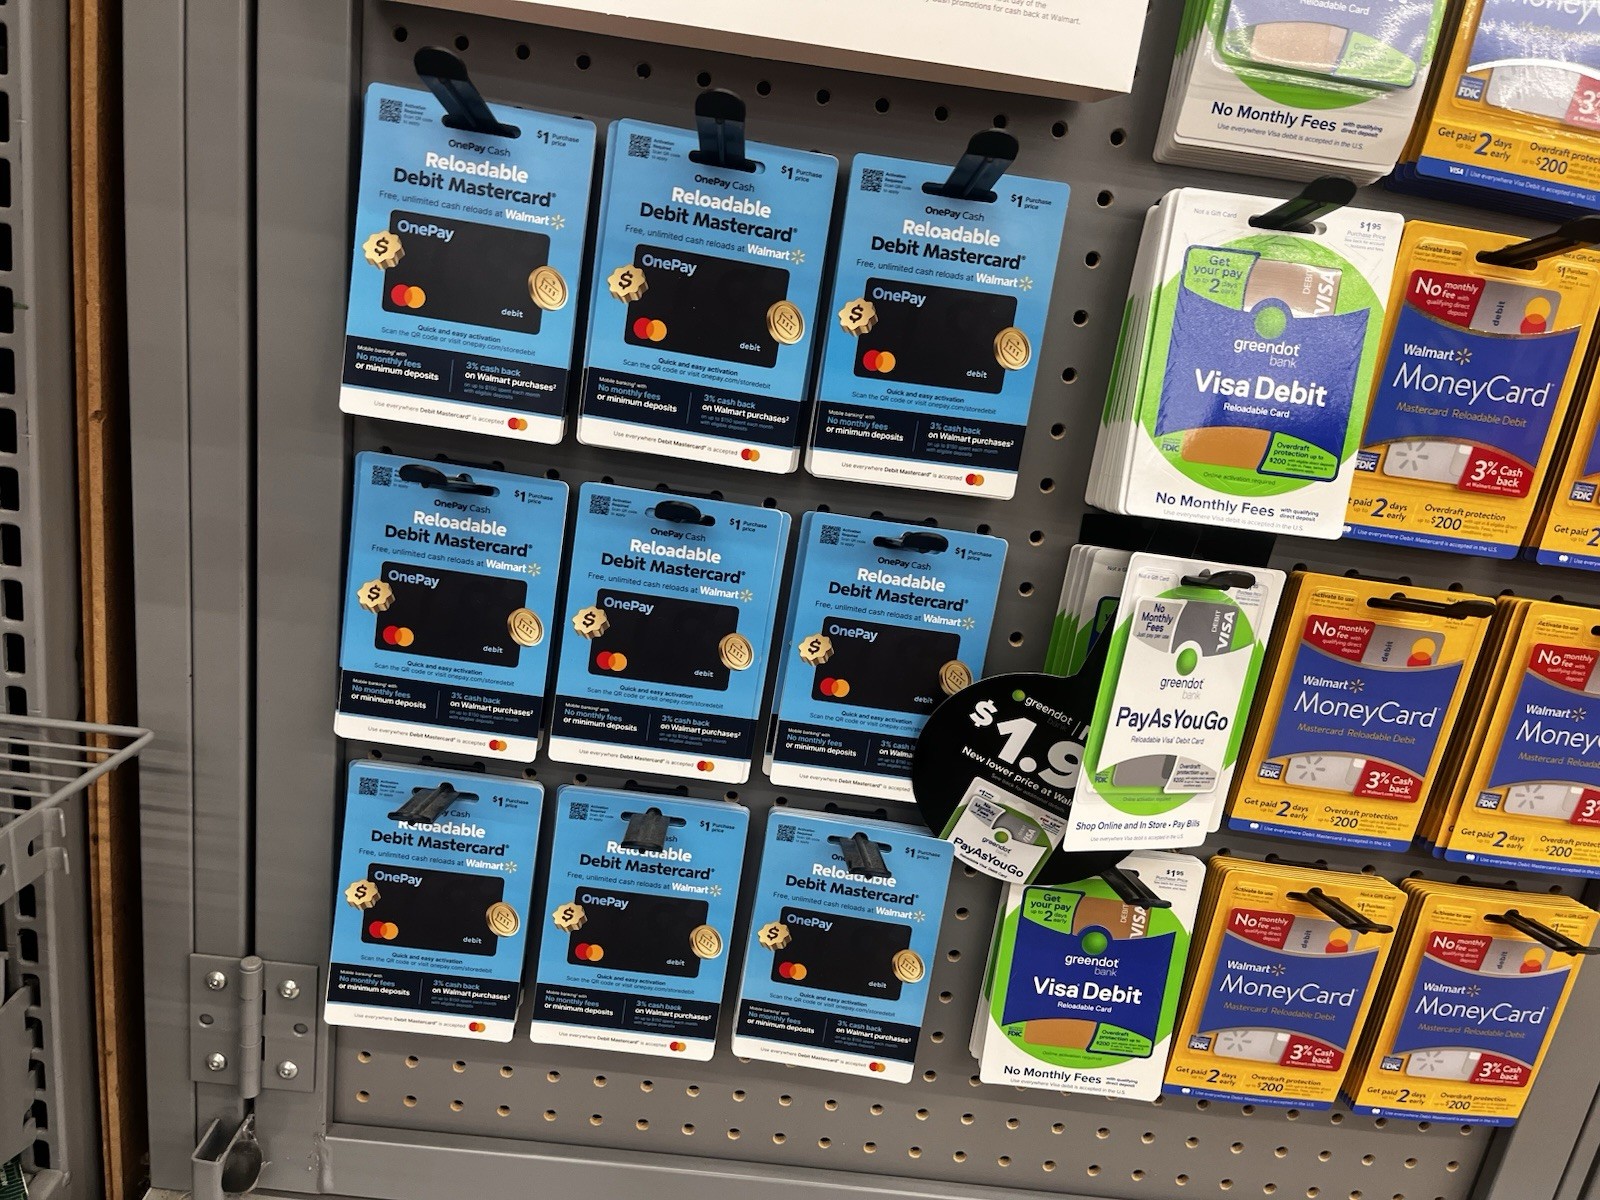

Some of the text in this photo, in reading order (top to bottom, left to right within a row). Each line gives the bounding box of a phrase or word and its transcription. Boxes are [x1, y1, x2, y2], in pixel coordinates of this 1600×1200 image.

[952, 0, 992, 11] promotions
[993, 4, 1002, 12] for
[1004, 7, 1022, 16] cash
[1023, 10, 1040, 18] back
[1050, 14, 1080, 25] Walmart.
[1458, 86, 1480, 99] FDIC
[1212, 102, 1336, 131] No Monthly Fees
[537, 130, 548, 144] $1
[1231, 125, 1266, 136] everywhere
[1268, 130, 1280, 138] Visa
[1305, 137, 1333, 146] accepted
[1438, 127, 1512, 156] Get paid 2 days
[447, 138, 511, 157] OnePay Cash
[1490, 149, 1511, 162] early
[425, 151, 529, 184] Reloadable
[1536, 157, 1568, 175] $200
[394, 168, 444, 190] Debit
[379, 190, 399, 201] Free,
[402, 196, 441, 208] unlimited
[441, 202, 460, 210] cash
[462, 204, 492, 215] reloads
[504, 208, 549, 226] Walmart
[672, 187, 770, 217] Reloadable
[640, 202, 688, 223] Debit
[398, 220, 453, 241] OnePay
[903, 220, 999, 246] Reloadable
[872, 235, 918, 255] Debit
[642, 254, 696, 276] OnePay
[1209, 255, 1231, 266] Get
[1193, 265, 1243, 279] your pay
[1209, 278, 1220, 293] 2
[1415, 277, 1441, 295] No
[873, 287, 925, 307] OnePay
[501, 309, 522, 317] debit
[417, 324, 436, 333] Quick
[468, 333, 500, 342] activation
[1234, 340, 1299, 360] greendot
[1404, 344, 1453, 360] Walmart
[356, 352, 421, 368] No monthly fees
[465, 360, 520, 377] 3% cash back
[1268, 354, 1296, 368] bank
[365, 364, 401, 374] minimum
[404, 369, 438, 380] deposits
[477, 372, 510, 384] Walmart
[1196, 369, 1329, 408] Visa Debit
[1394, 363, 1549, 406] MoneyCard
[1222, 402, 1289, 418] Reloadable Card
[1470, 460, 1497, 480] 3%
[1498, 466, 1522, 479] Cash
[1496, 476, 1518, 489] back
[1156, 492, 1274, 516] No Monthly Fees
[414, 509, 506, 535] Reloadable
[385, 525, 430, 543] Debit
[629, 538, 722, 564] Reloadable
[600, 552, 646, 571] Debit
[388, 570, 439, 588] OnePay
[858, 568, 944, 591] Reloadable
[828, 581, 871, 598] Debit
[604, 597, 653, 615] OnePay
[829, 624, 877, 642] OnePay
[1312, 621, 1335, 636] No
[1160, 678, 1203, 690] greendot
[1303, 675, 1348, 689] Walmart
[1025, 696, 1073, 726] greendot
[1294, 692, 1436, 726] MoneyCard
[1116, 706, 1227, 731] PayAsYouGo
[1516, 719, 1600, 754] Money
[962, 746, 985, 763] New
[986, 757, 1013, 777] lower
[1014, 774, 1039, 792] price
[1040, 785, 1052, 798] at
[1365, 771, 1389, 788] 3%
[1075, 821, 1096, 831] Shop
[1097, 821, 1122, 829] Online
[1123, 821, 1138, 829] and
[1148, 820, 1166, 828] Store
[1172, 820, 1185, 829] Pay
[1186, 819, 1199, 827] Bills
[1330, 816, 1358, 828] $200
[371, 830, 413, 845] Debit
[578, 853, 621, 870] Debit
[953, 836, 1024, 878] PayAsYouGo
[374, 870, 422, 886] OnePay
[784, 874, 827, 892] Debit
[582, 894, 628, 910] OnePay
[787, 914, 832, 931] OnePay
[1226, 960, 1270, 974] Walmart
[1034, 976, 1141, 1004] Visa Debit
[1220, 974, 1354, 1005] MoneyCard
[1422, 982, 1465, 993] Walmart
[1056, 1000, 1112, 1012] Reloadable Card
[1416, 996, 1544, 1023] MoneyCard
[1004, 1065, 1101, 1083] No Monthly Fees
[1258, 1082, 1283, 1092] $200
[1446, 1100, 1470, 1109] $200
